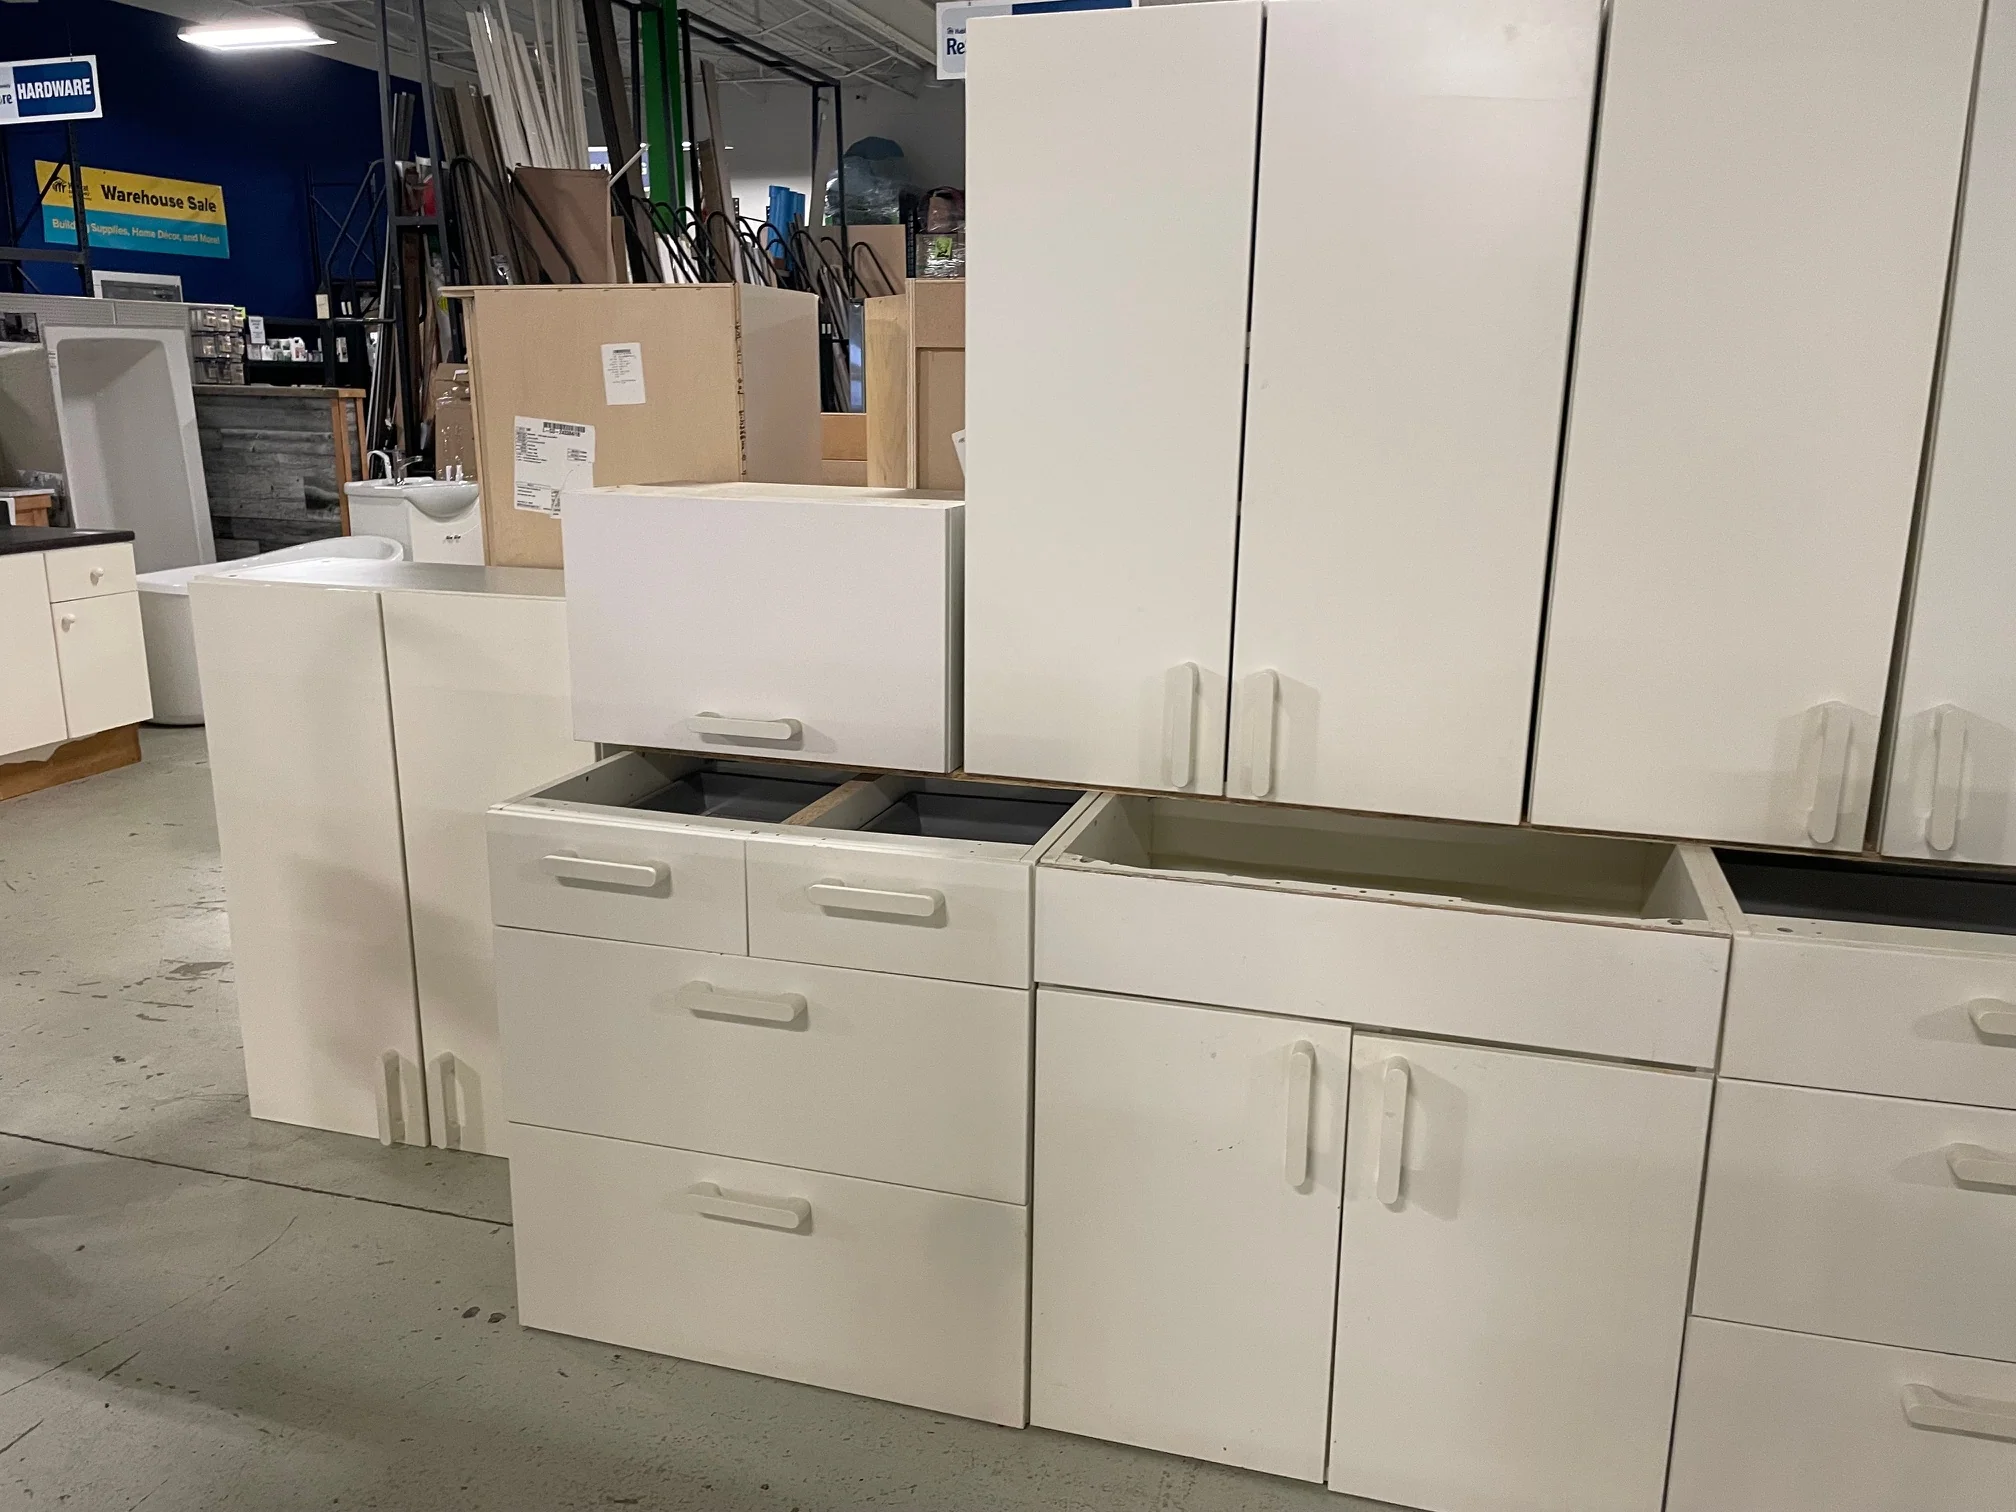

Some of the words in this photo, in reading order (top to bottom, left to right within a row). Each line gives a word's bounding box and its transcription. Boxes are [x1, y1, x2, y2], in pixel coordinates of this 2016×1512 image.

[947, 38, 967, 55] Re
[17, 77, 91, 100] HARDWARE
[100, 184, 184, 209] Warehouse
[187, 196, 217, 212] Sale
[90, 222, 130, 236] Supplies,
[131, 227, 156, 238] Home
[183, 233, 199, 242] and
